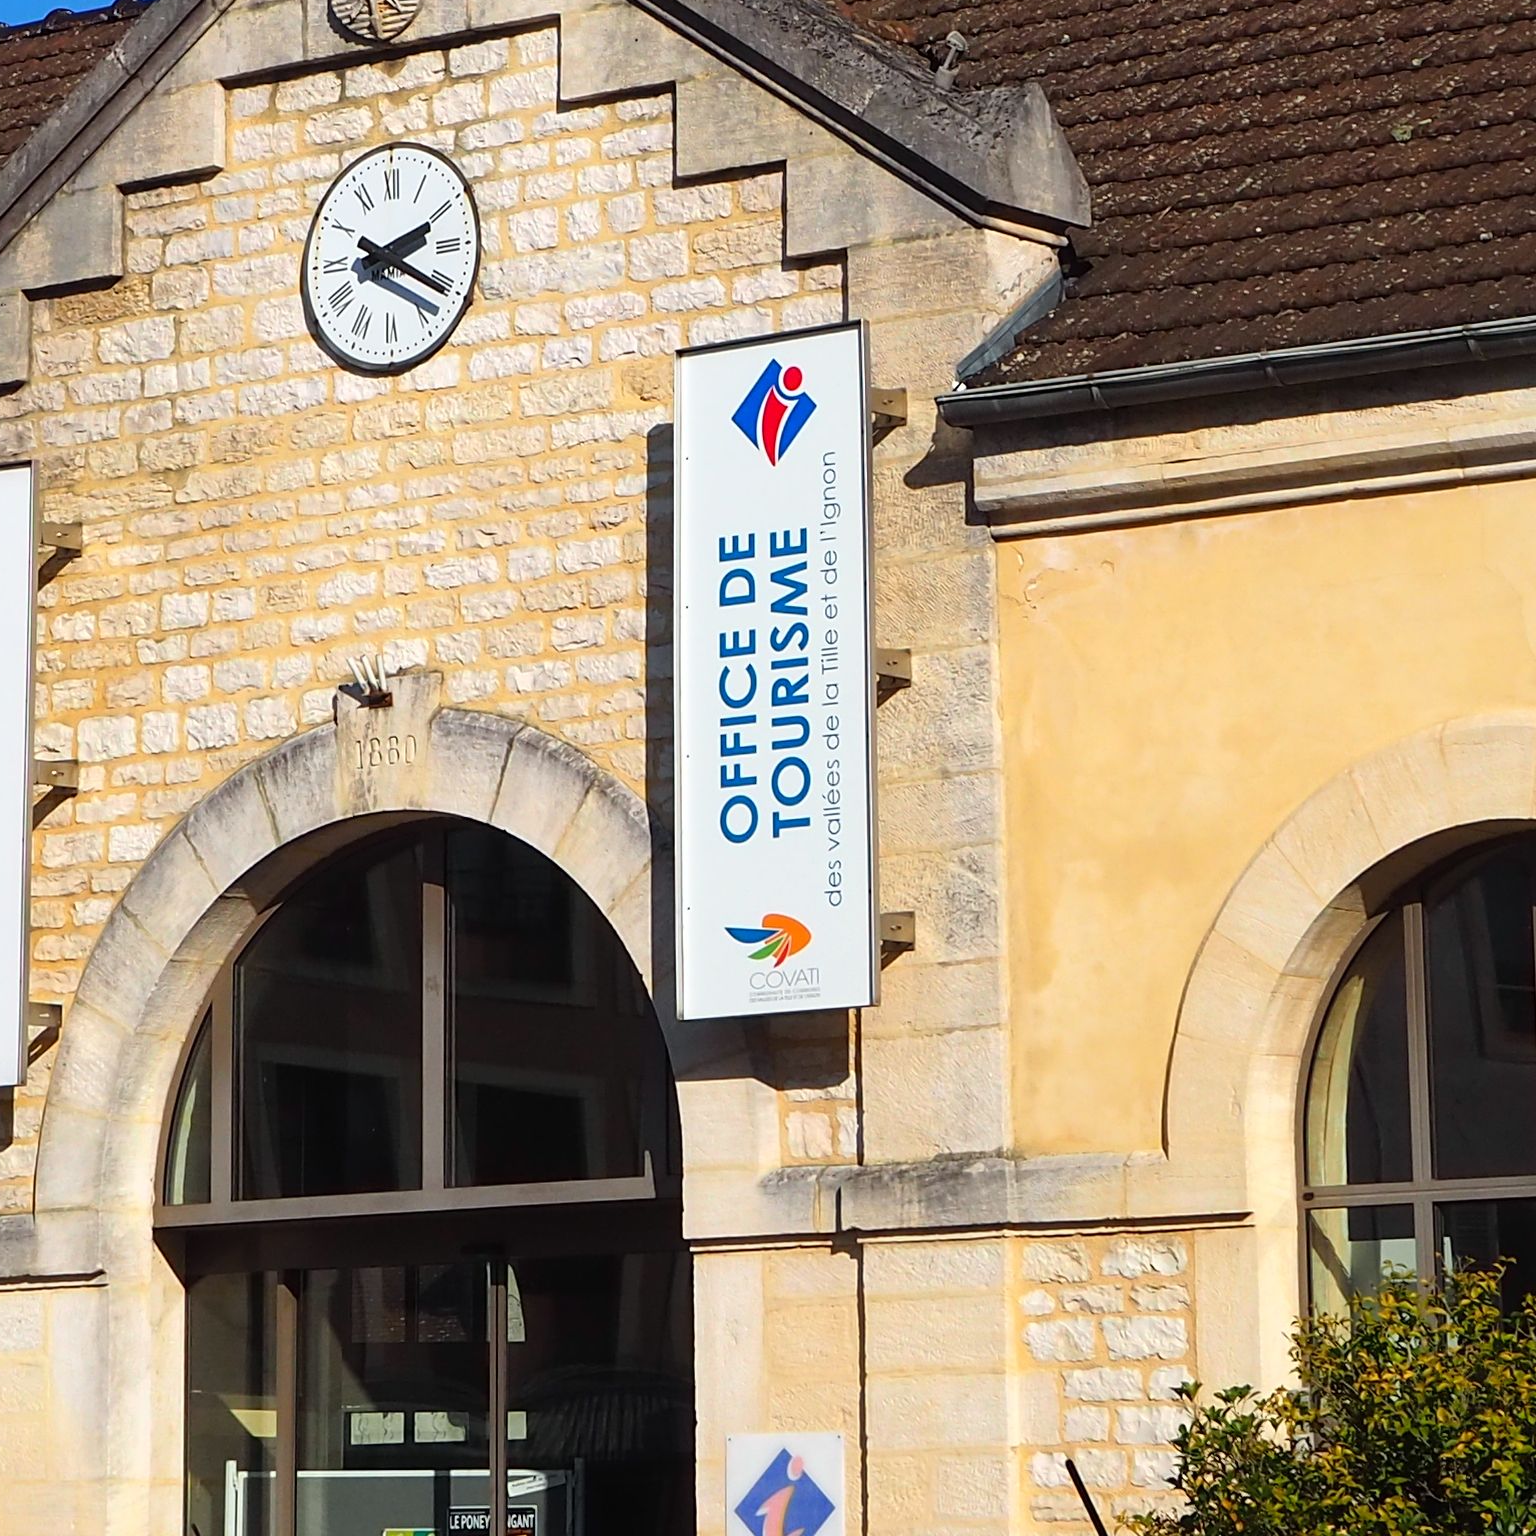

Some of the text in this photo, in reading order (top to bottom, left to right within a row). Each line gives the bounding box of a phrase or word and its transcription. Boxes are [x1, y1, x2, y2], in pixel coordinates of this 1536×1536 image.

[718, 532, 760, 845] OFFICE DE
[769, 527, 812, 839] TOURISME
[819, 451, 843, 908] des vallées de la Tille et de l'Ignon
[750, 968, 820, 990] COVATI
[449, 1514, 460, 1530] LE
[461, 1514, 491, 1530] PONEY
